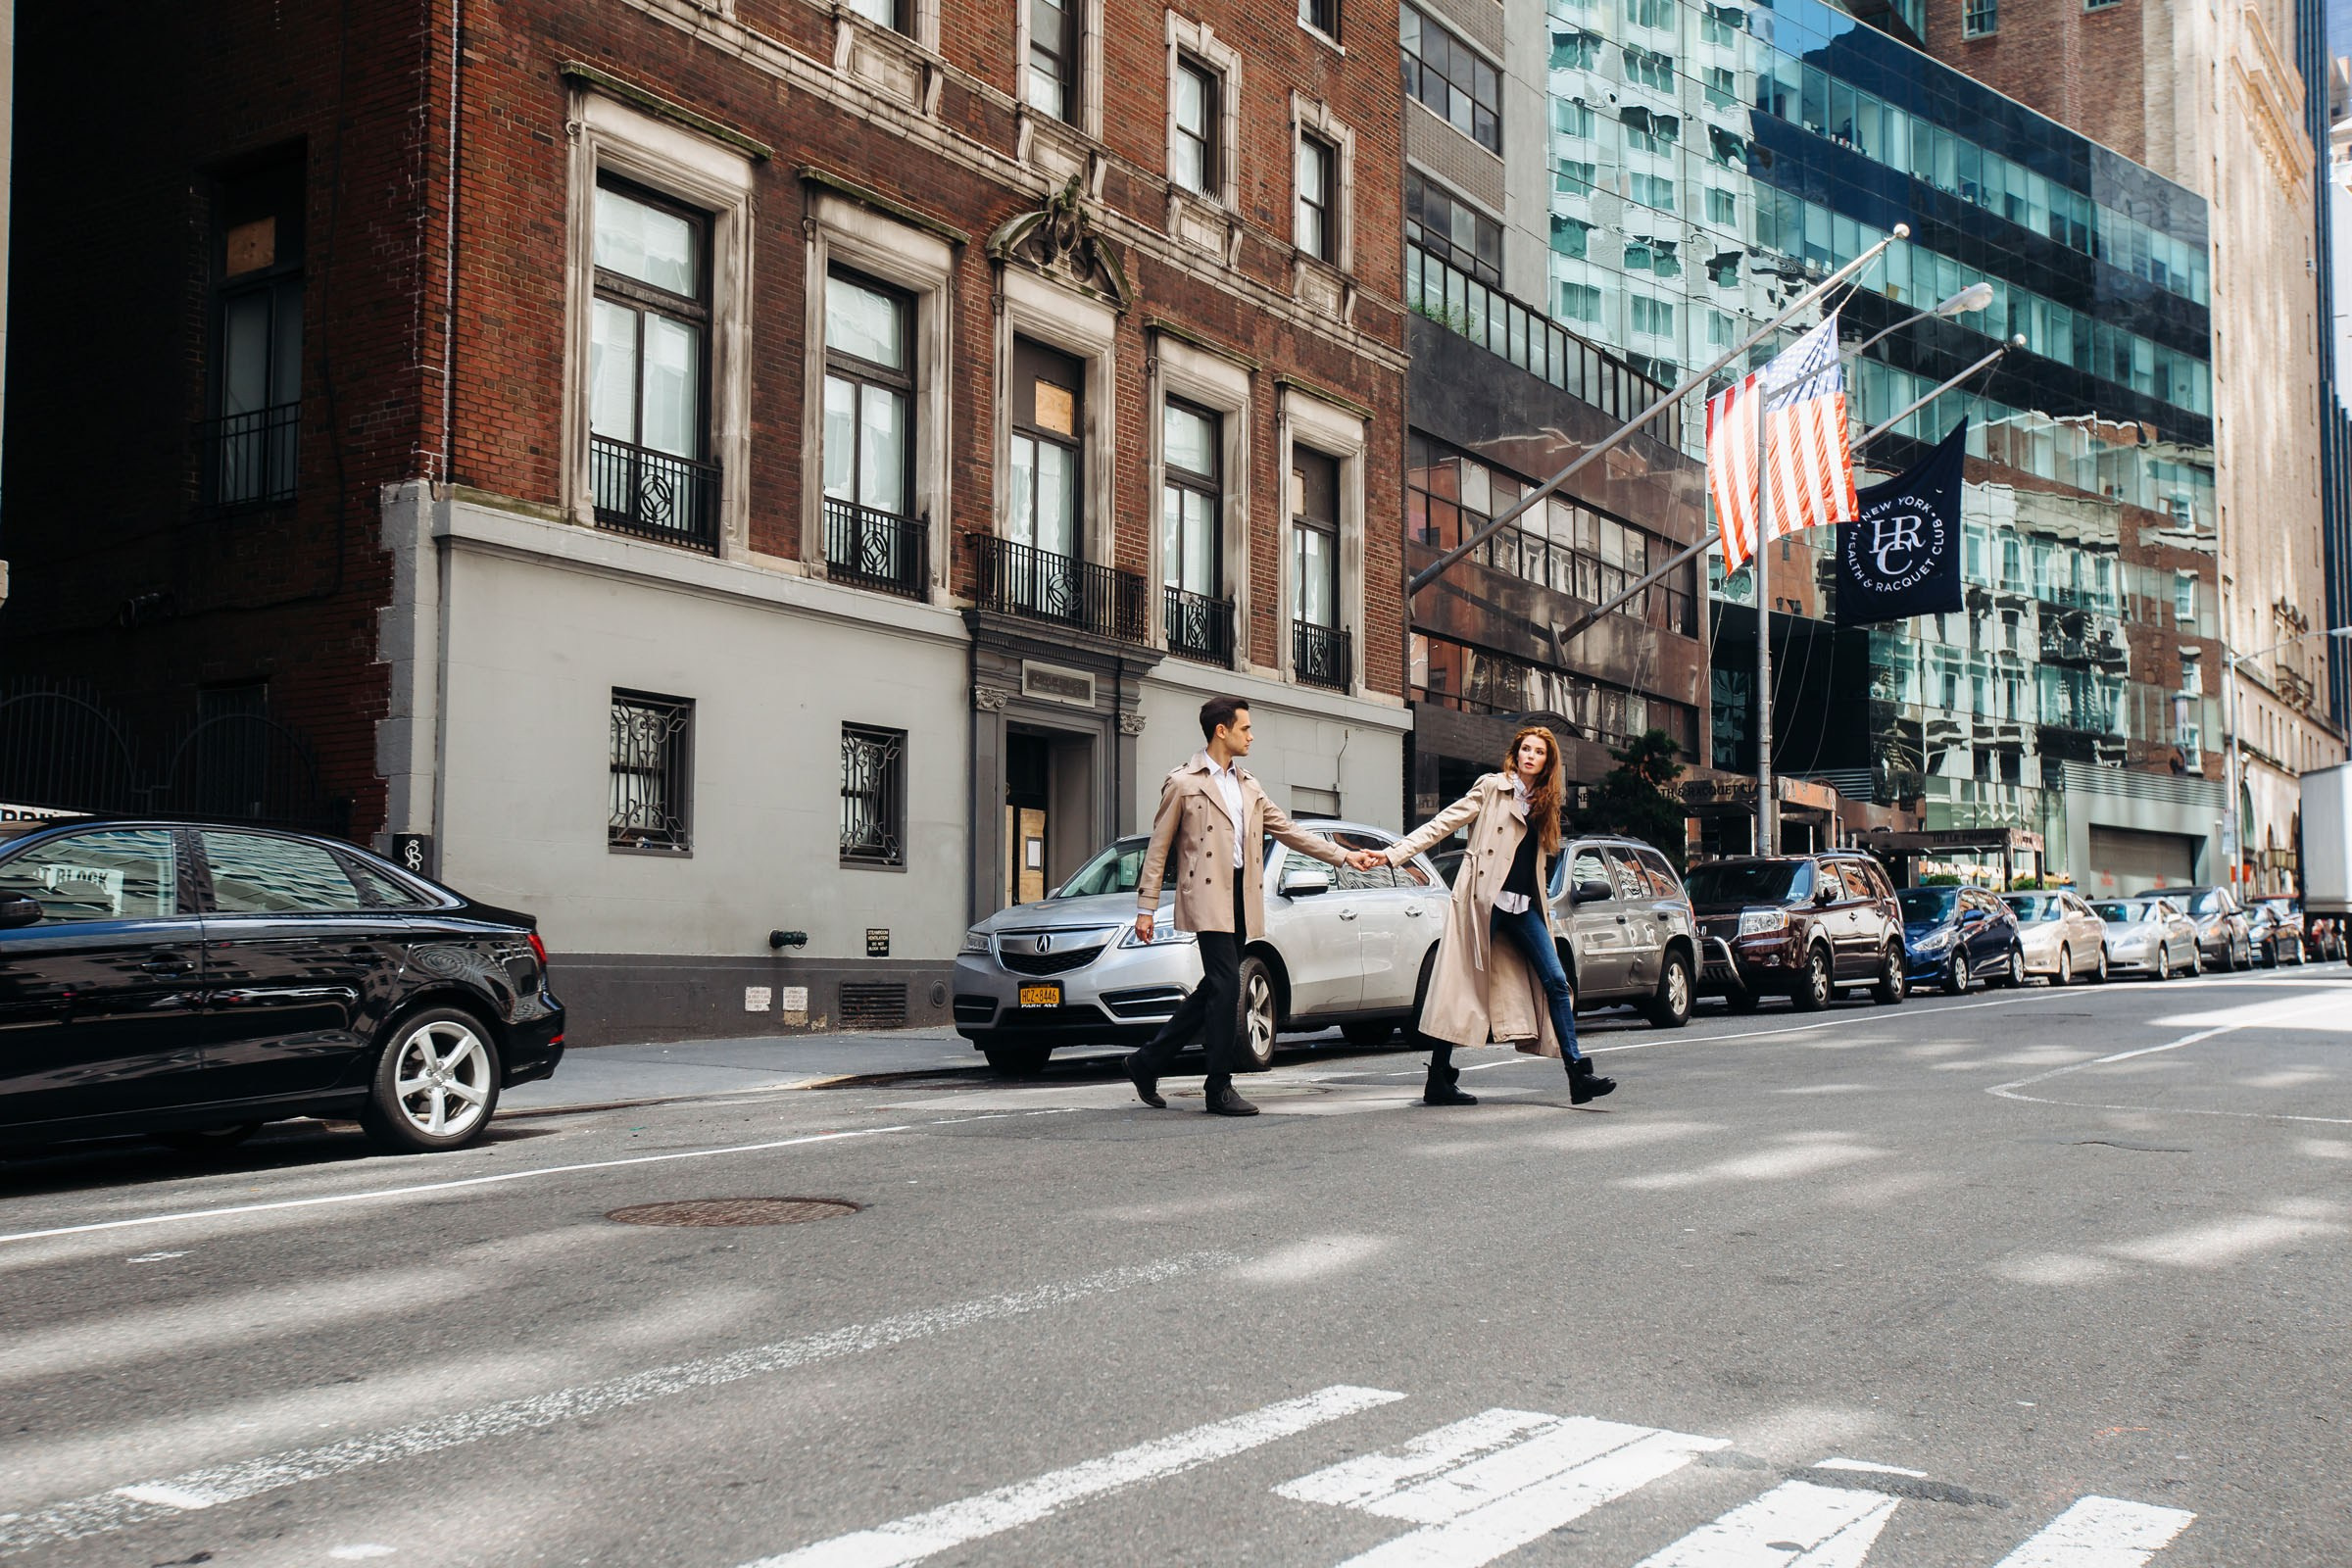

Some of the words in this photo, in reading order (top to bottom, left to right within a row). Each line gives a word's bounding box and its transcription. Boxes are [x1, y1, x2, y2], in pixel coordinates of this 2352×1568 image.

[1861, 501, 1891, 521] NEW
[1897, 496, 1933, 514] YORK
[1847, 530, 1865, 581] HEALTH
[1863, 578, 1874, 588] &
[1875, 558, 1936, 593] RACQUET
[1932, 518, 1945, 556] CLUB
[1688, 784, 1739, 797] RACQUET
